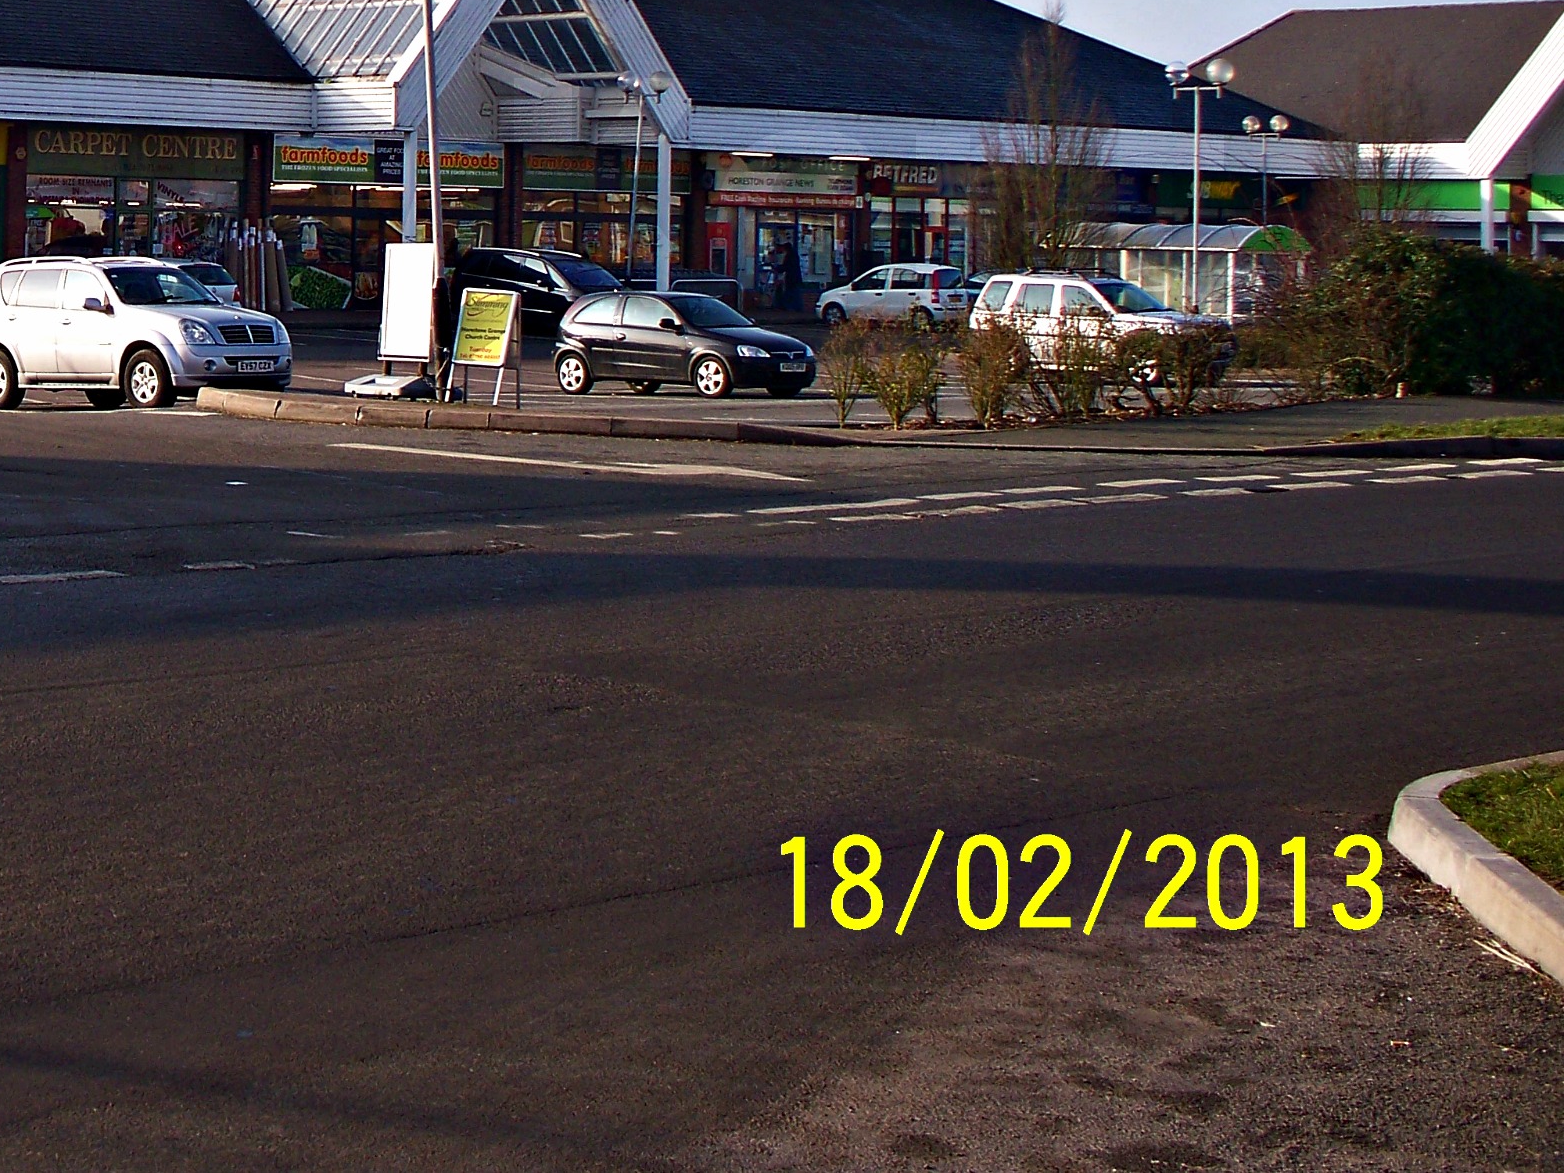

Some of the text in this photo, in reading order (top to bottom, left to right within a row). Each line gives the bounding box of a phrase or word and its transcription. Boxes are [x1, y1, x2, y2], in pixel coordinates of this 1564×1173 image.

[35, 129, 236, 160] CARPET CENTRE
[281, 145, 368, 165] farmfoods
[416, 149, 498, 168] famfoods
[526, 155, 594, 171] farmfoods
[795, 179, 814, 188] NEWS
[1186, 180, 1242, 201] SBWAY
